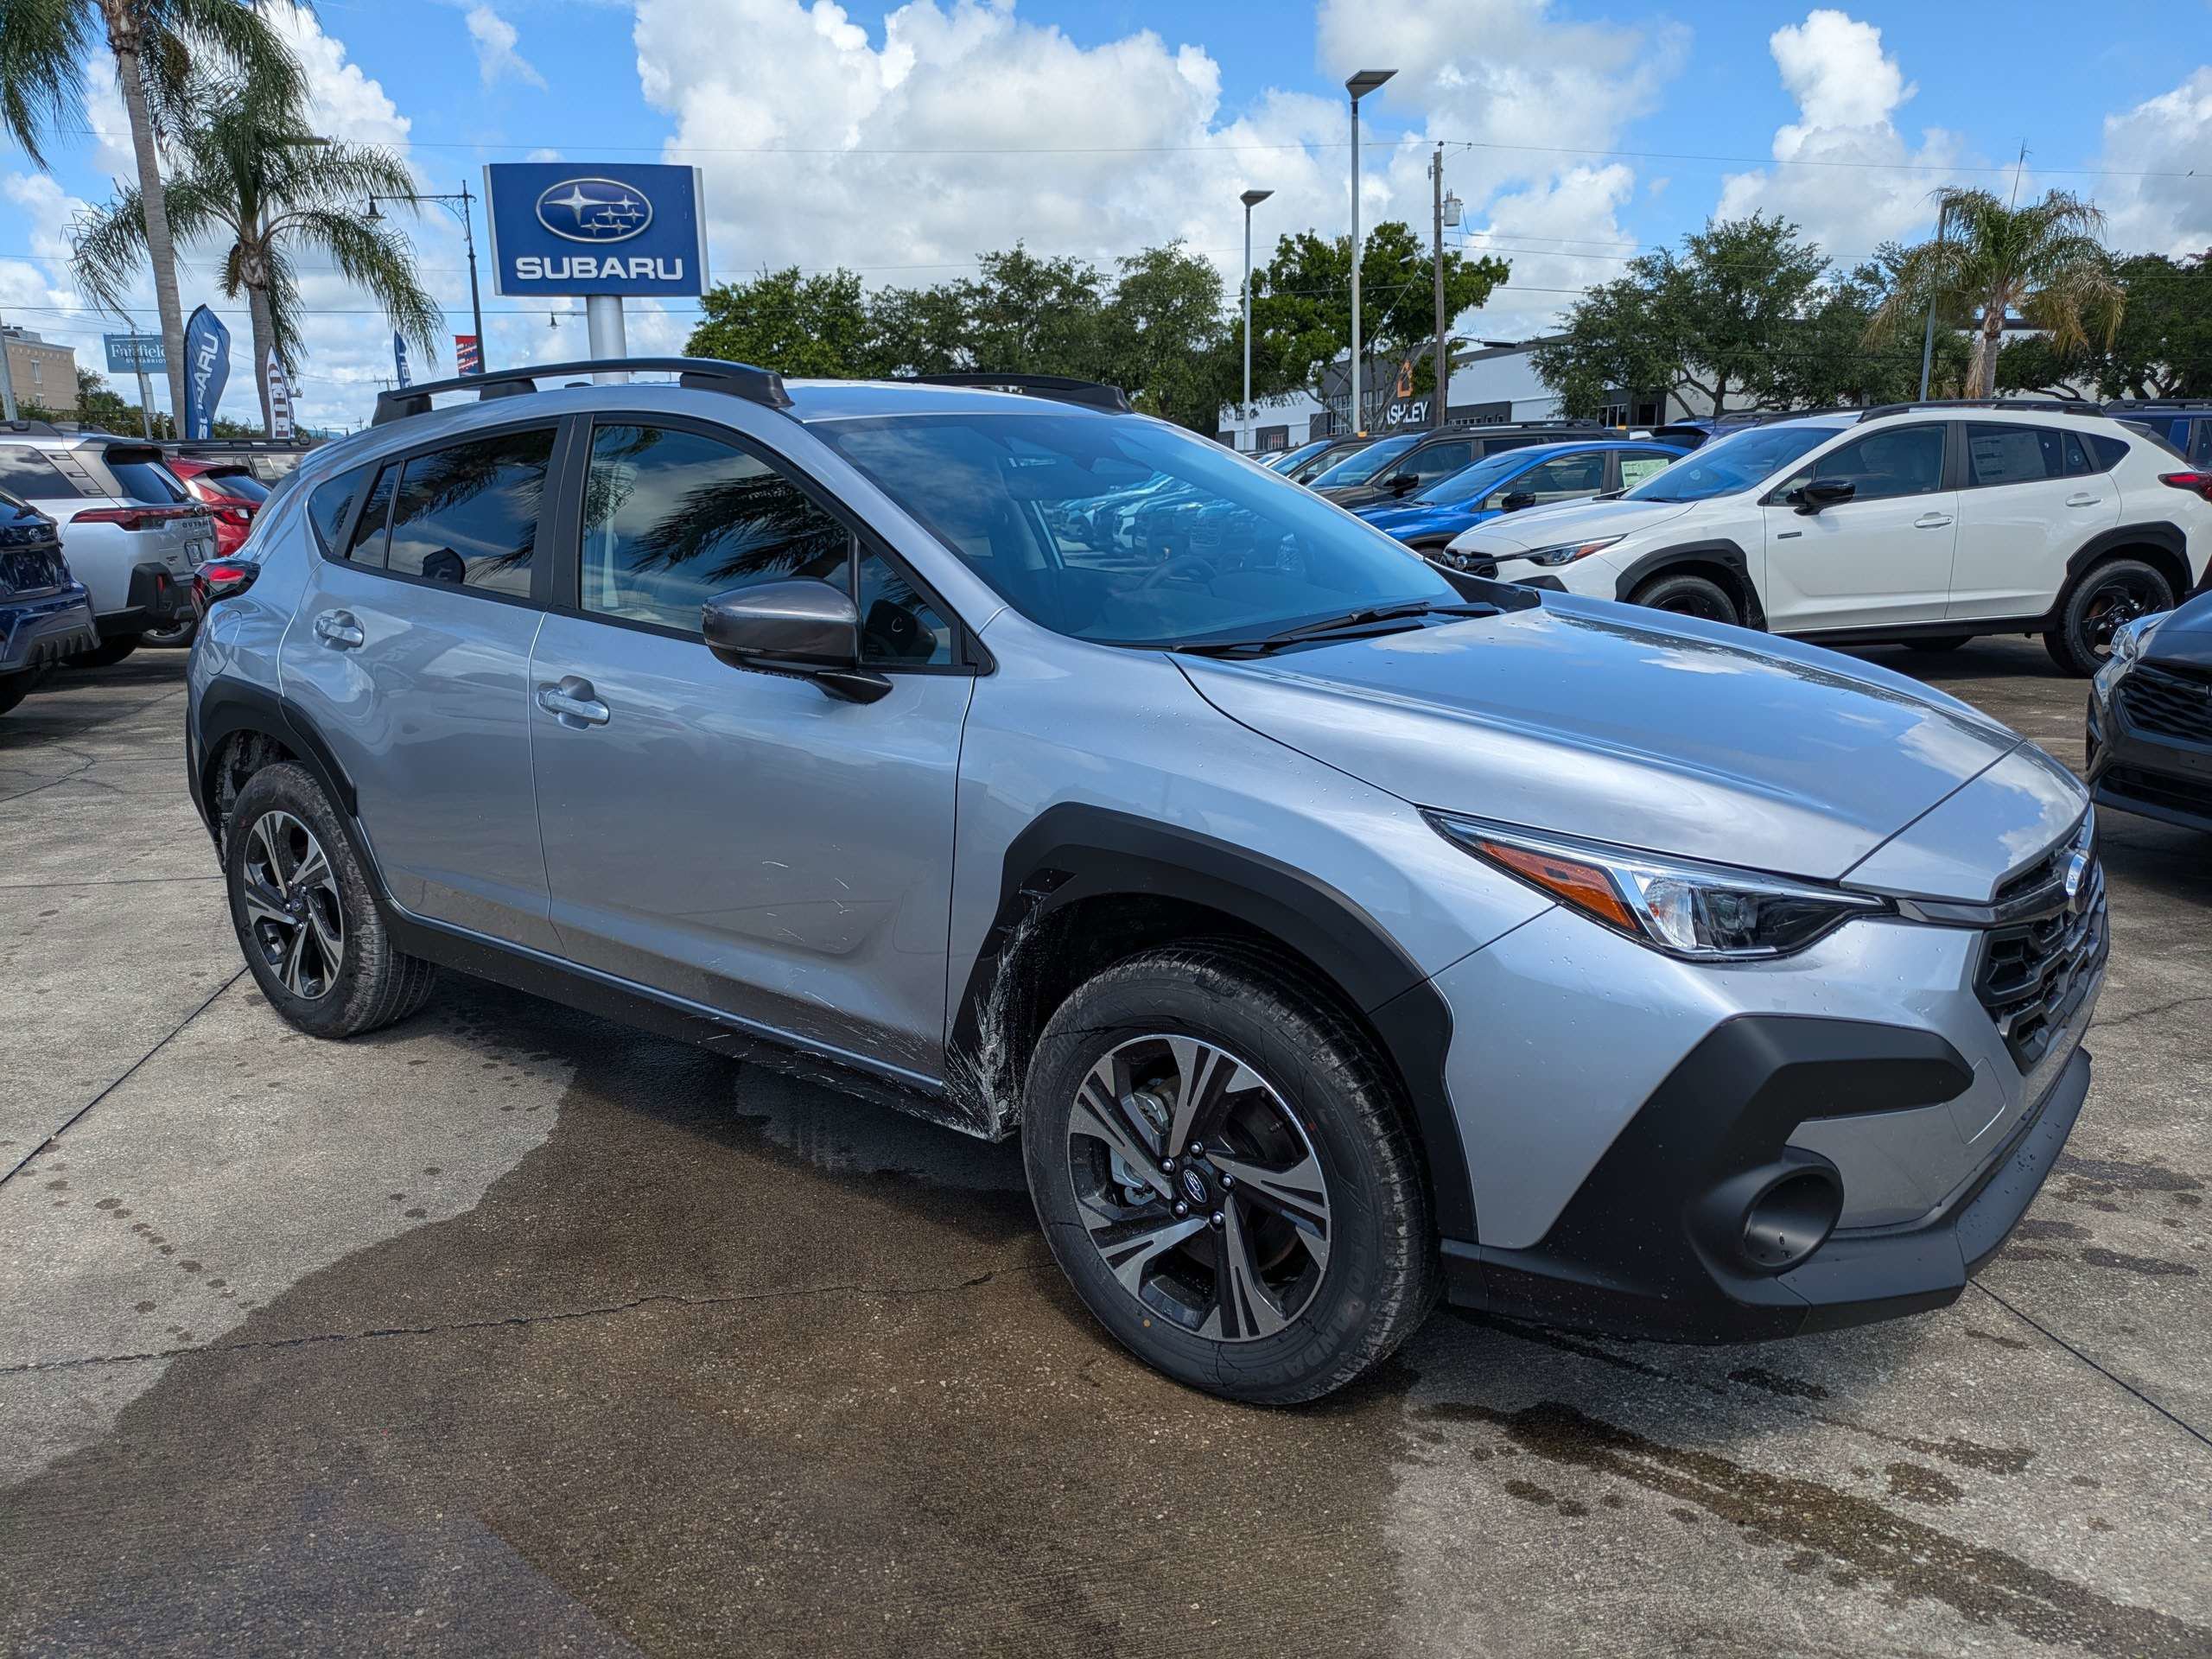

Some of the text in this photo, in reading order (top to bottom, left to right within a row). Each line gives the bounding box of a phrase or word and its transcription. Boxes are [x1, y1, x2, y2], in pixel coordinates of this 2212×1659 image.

[516, 257, 683, 280] SUBARU
[111, 344, 166, 359] Faifiel
[194, 332, 219, 439] SUARU
